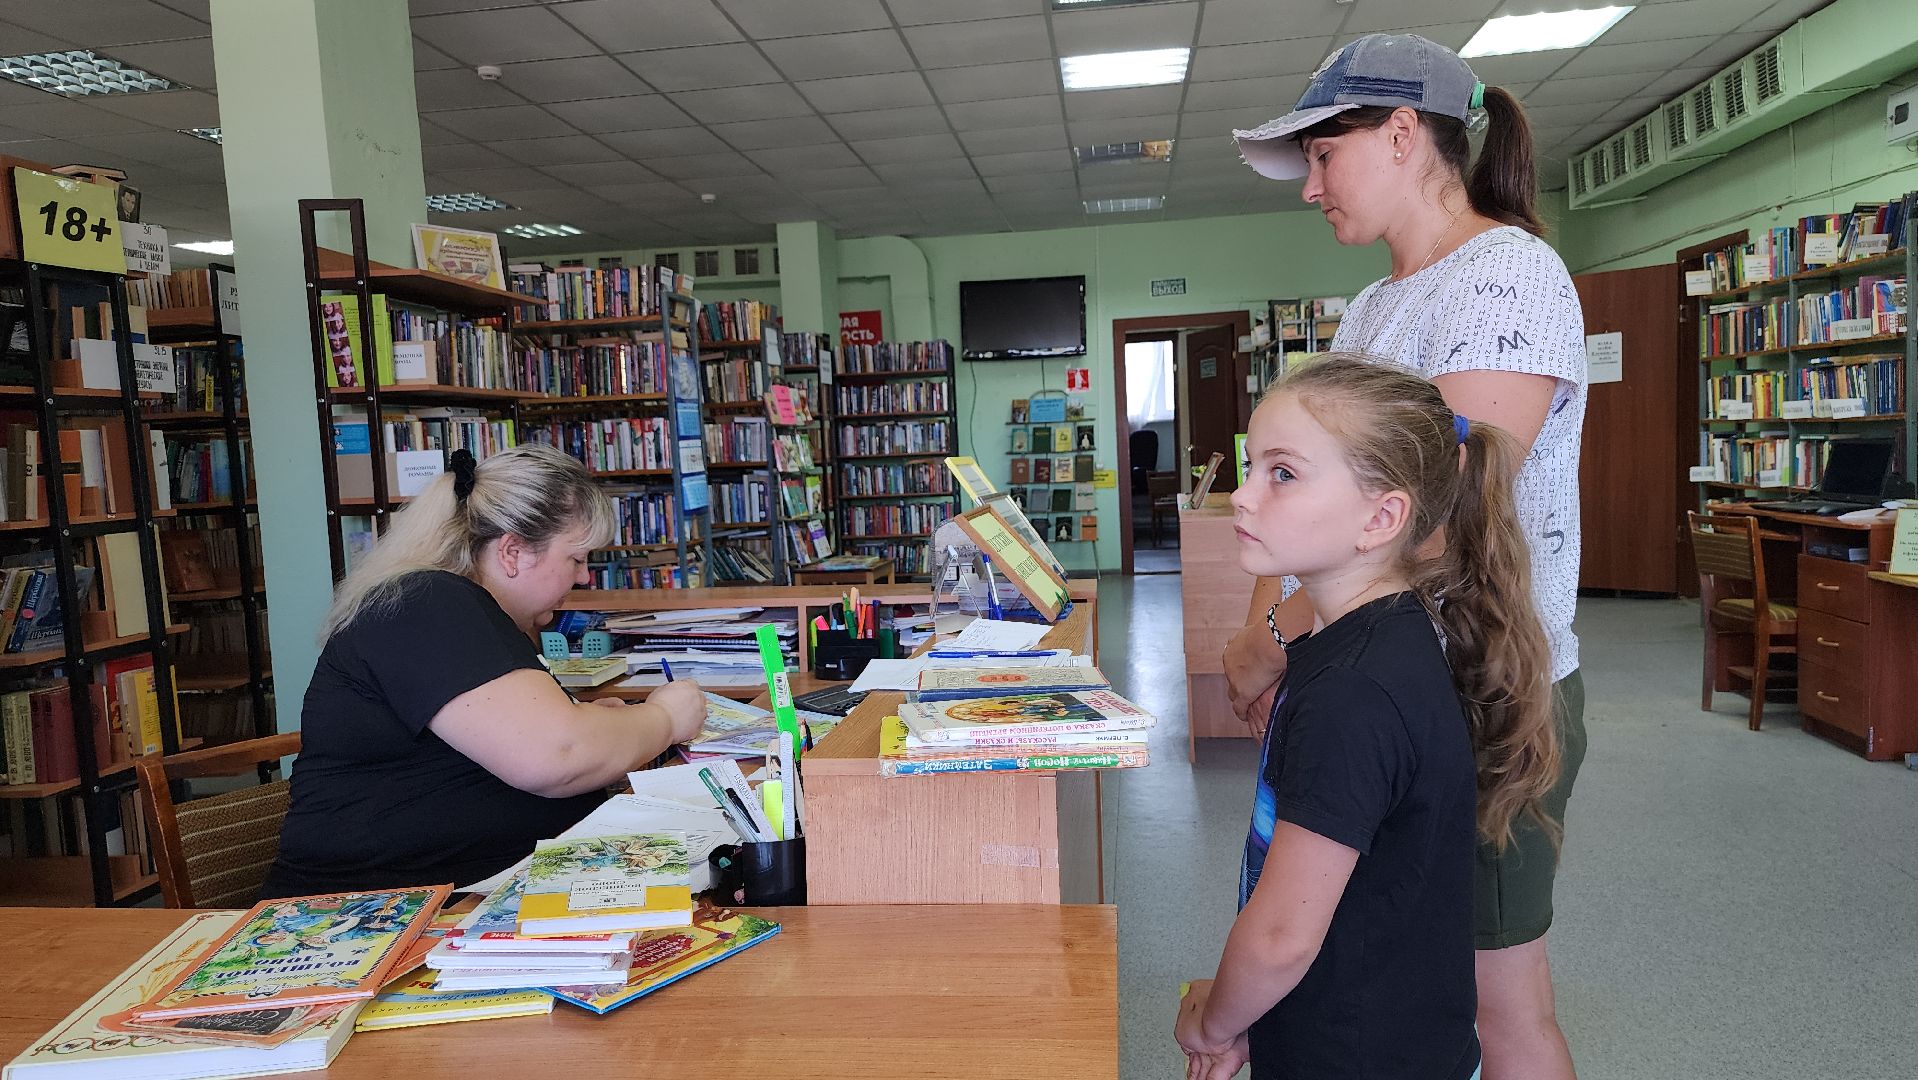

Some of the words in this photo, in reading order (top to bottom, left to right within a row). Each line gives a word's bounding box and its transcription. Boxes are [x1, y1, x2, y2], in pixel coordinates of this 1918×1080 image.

[39, 200, 112, 243] 18+
[1152, 285, 1184, 296] ВЫХОД
[221, 299, 240, 311] ЛИТ
[840, 316, 859, 328] АЯ
[841, 329, 875, 341] ОСТЬ
[1073, 722, 1106, 730] СКАЗКА
[254, 953, 334, 966] СЛОВО
[213, 960, 360, 978] ВОЛШЕБНОЕ
